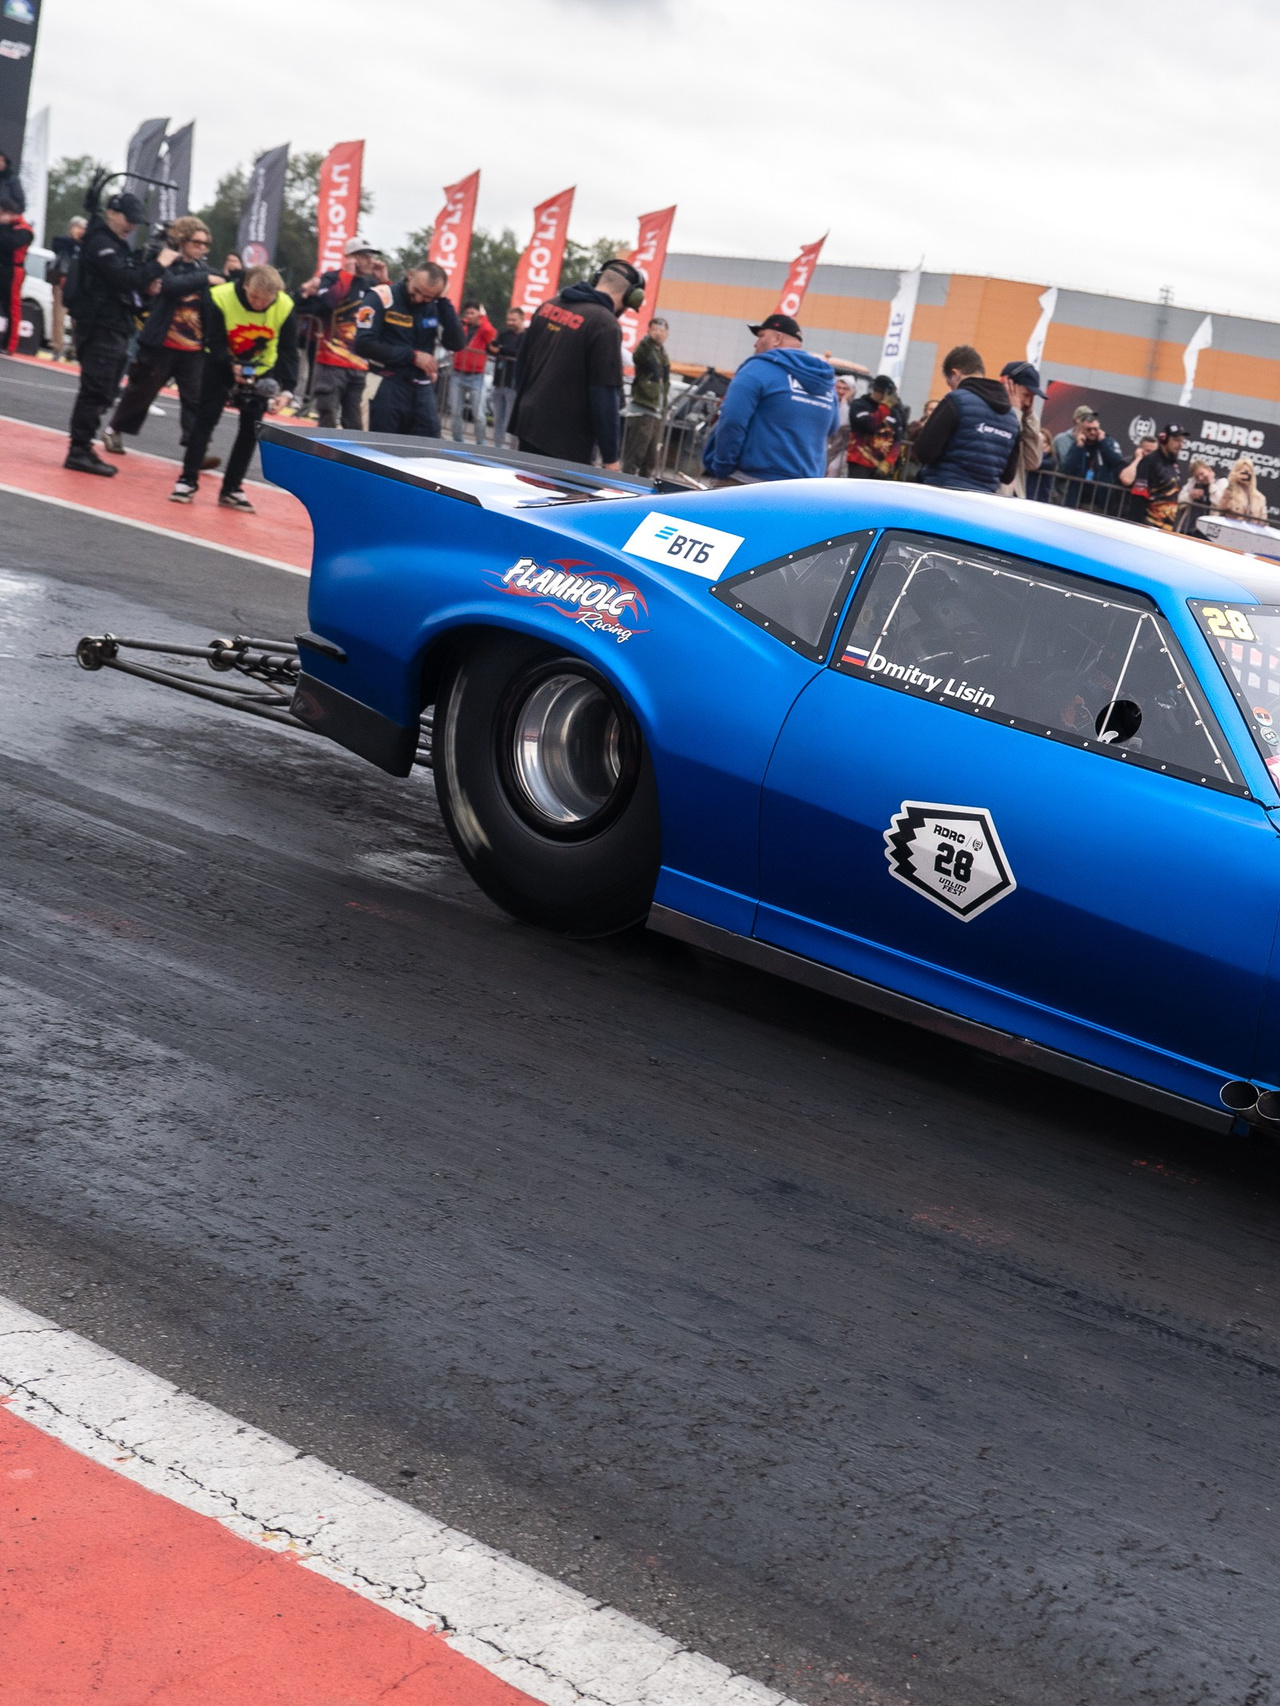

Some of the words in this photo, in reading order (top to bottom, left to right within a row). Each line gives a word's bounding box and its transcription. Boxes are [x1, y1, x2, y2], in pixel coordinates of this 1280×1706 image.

[1200, 419, 1265, 449] RDRC
[667, 535, 715, 564] ВТБ
[502, 557, 637, 616] FLAMHOLC
[575, 611, 633, 644] Racing
[1201, 606, 1255, 641] 28
[868, 653, 943, 693] Dmitry
[943, 678, 996, 708] Lisin
[933, 824, 966, 844] RDRC
[934, 842, 974, 883] 28
[942, 884, 964, 896] FEST
